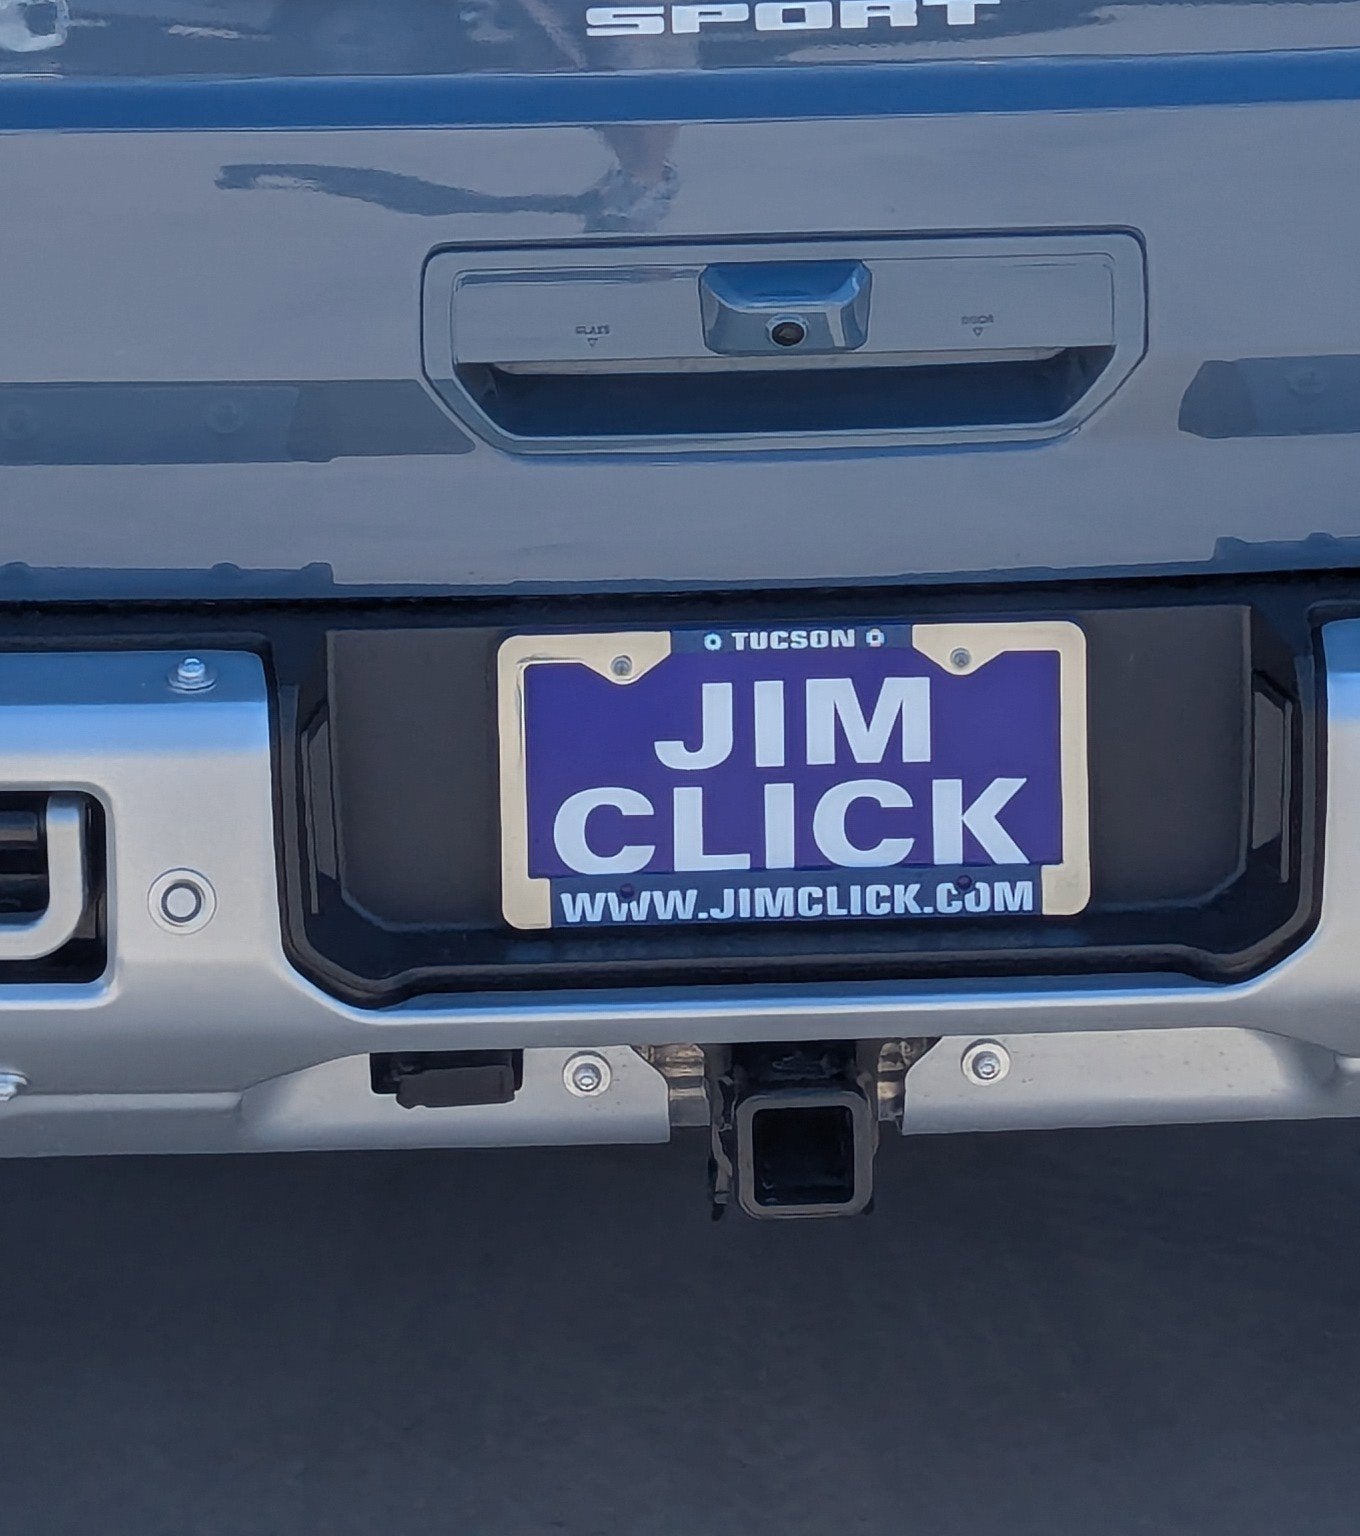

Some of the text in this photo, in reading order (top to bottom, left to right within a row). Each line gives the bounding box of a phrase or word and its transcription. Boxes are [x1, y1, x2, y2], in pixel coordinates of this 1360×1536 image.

[731, 629, 856, 651] TUCSON
[653, 676, 931, 771] JIM
[552, 776, 1031, 876] CLICK
[559, 880, 1035, 924] WWW.JIMCLICK.COM
